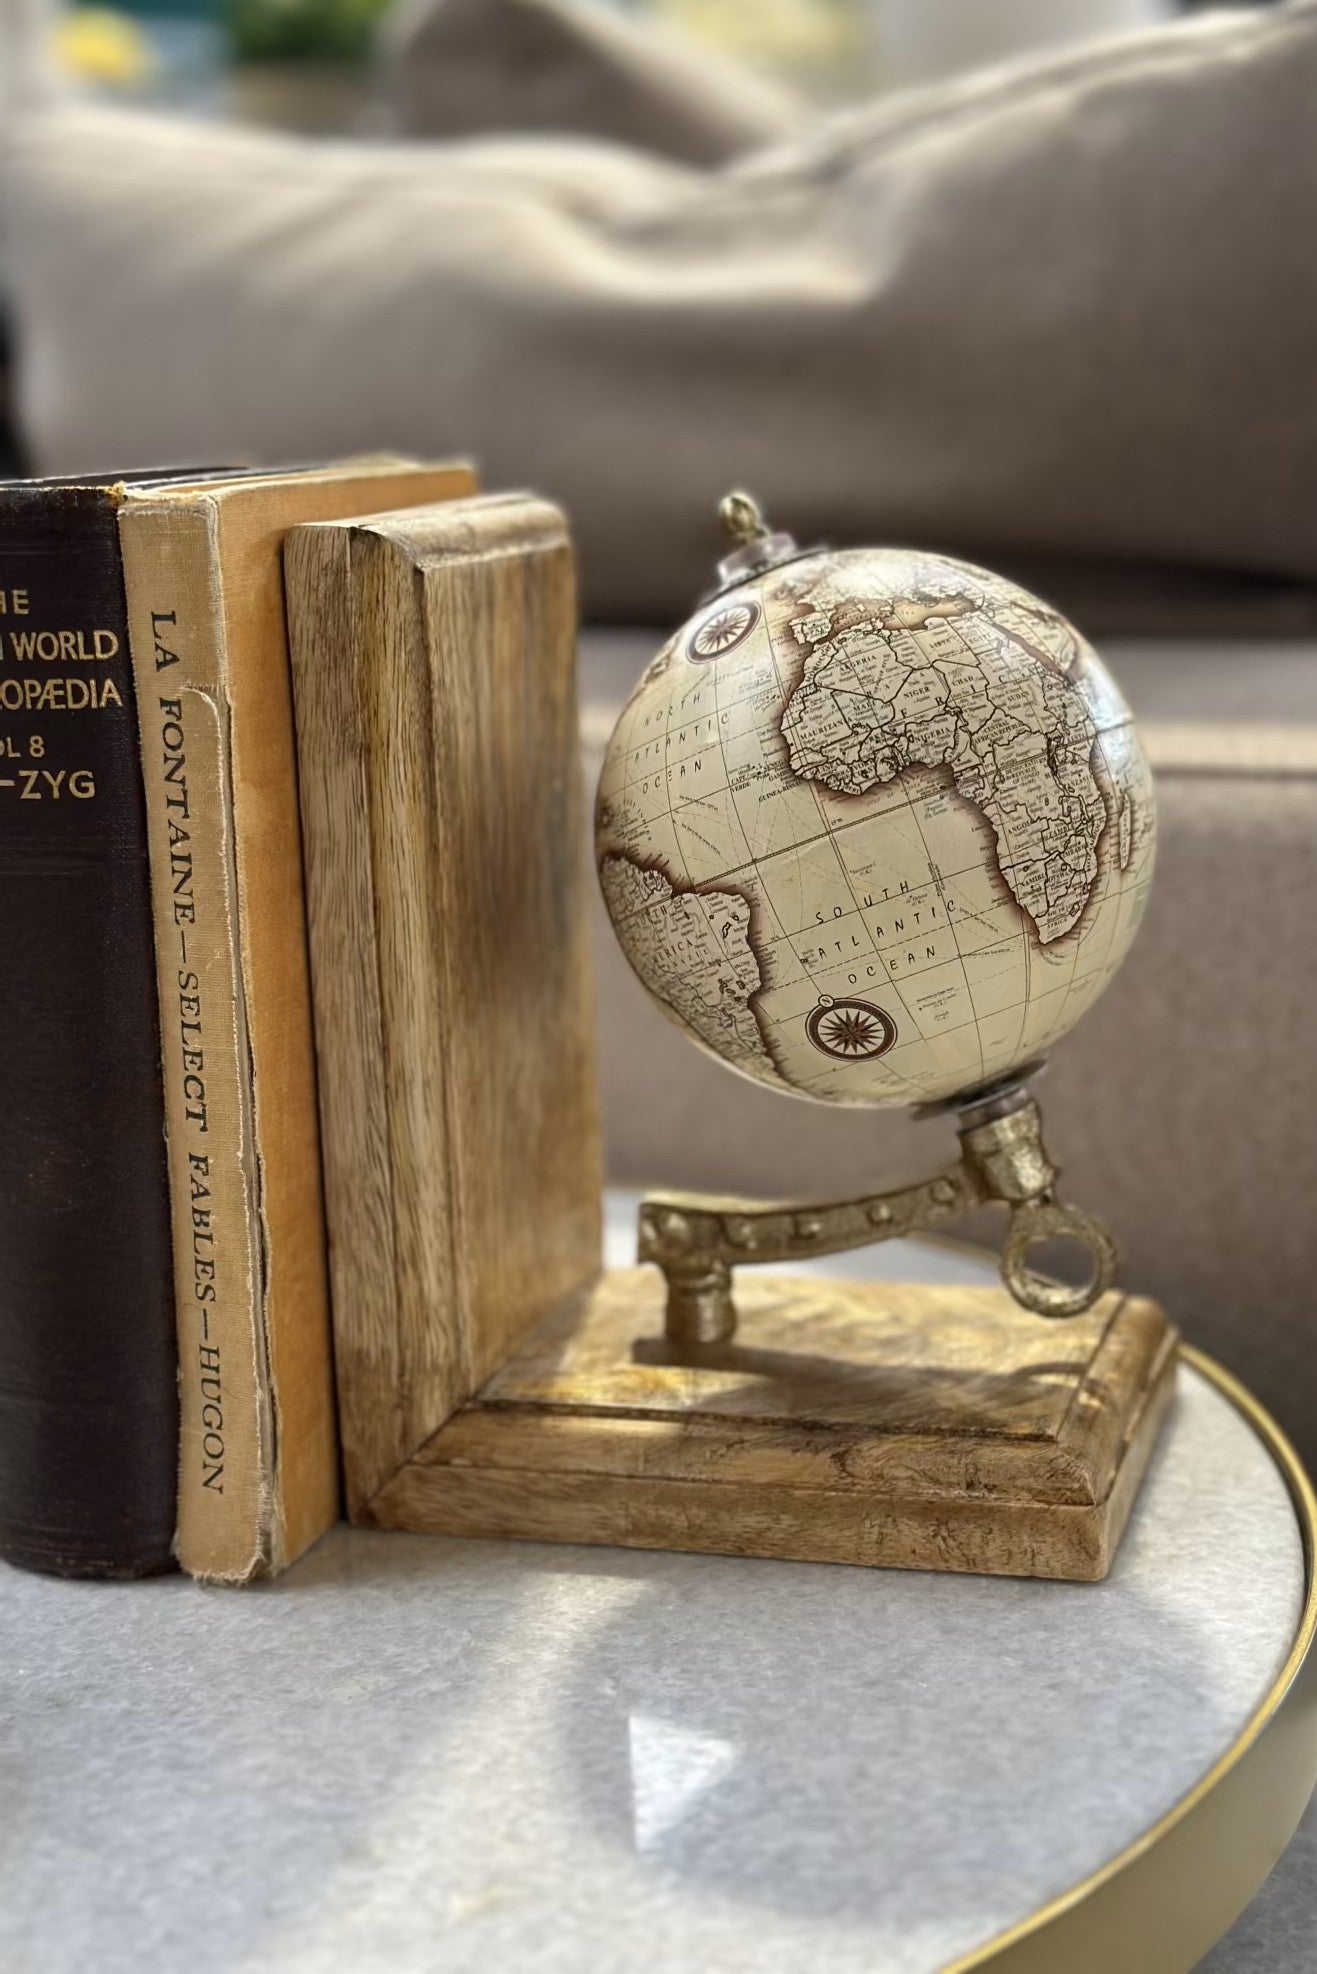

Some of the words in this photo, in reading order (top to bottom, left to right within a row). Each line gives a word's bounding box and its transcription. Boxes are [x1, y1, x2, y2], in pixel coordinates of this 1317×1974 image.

[10, 629, 120, 661] WORLD
[151, 611, 180, 672] LA
[0, 678, 123, 710] OPÆDIA
[903, 686, 931, 699] NIGER
[952, 675, 974, 686] CHAD
[644, 693, 701, 727] NORTH
[29, 735, 45, 758] 8
[634, 713, 729, 764] ATLANTIC
[642, 758, 702, 795] OCEAN
[816, 880, 910, 925] SOUTH
[818, 900, 956, 960] ATLANTIC
[848, 945, 936, 984] OCEAN
